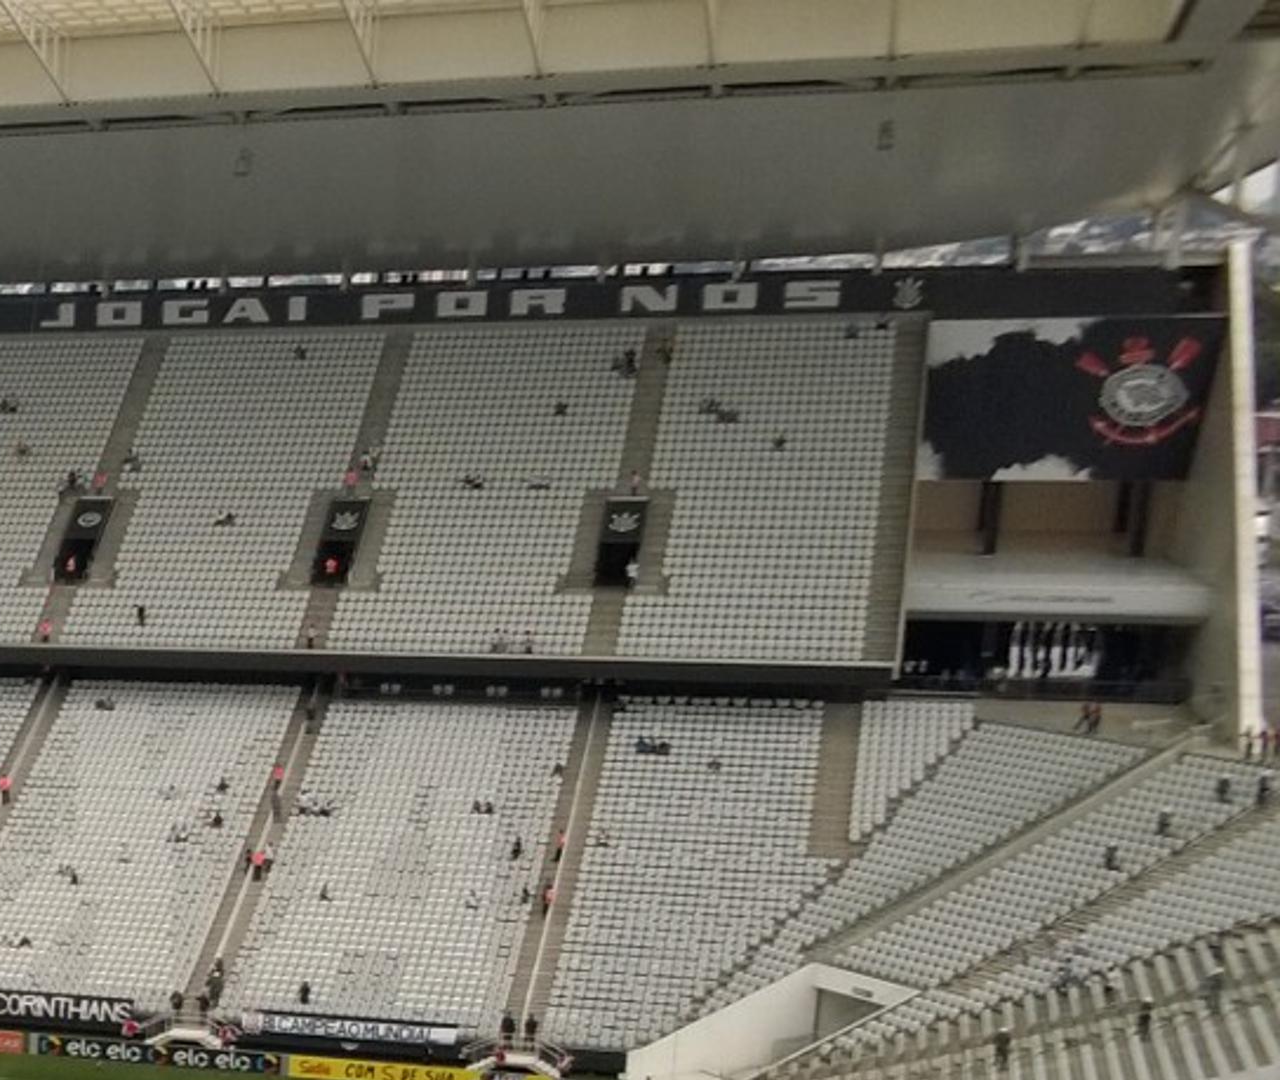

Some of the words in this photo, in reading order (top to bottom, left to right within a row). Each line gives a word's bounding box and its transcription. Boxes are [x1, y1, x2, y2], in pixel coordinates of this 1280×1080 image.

[40, 296, 307, 328] JOGAI
[361, 288, 566, 319] POR
[345, 1063, 375, 1079] COM
